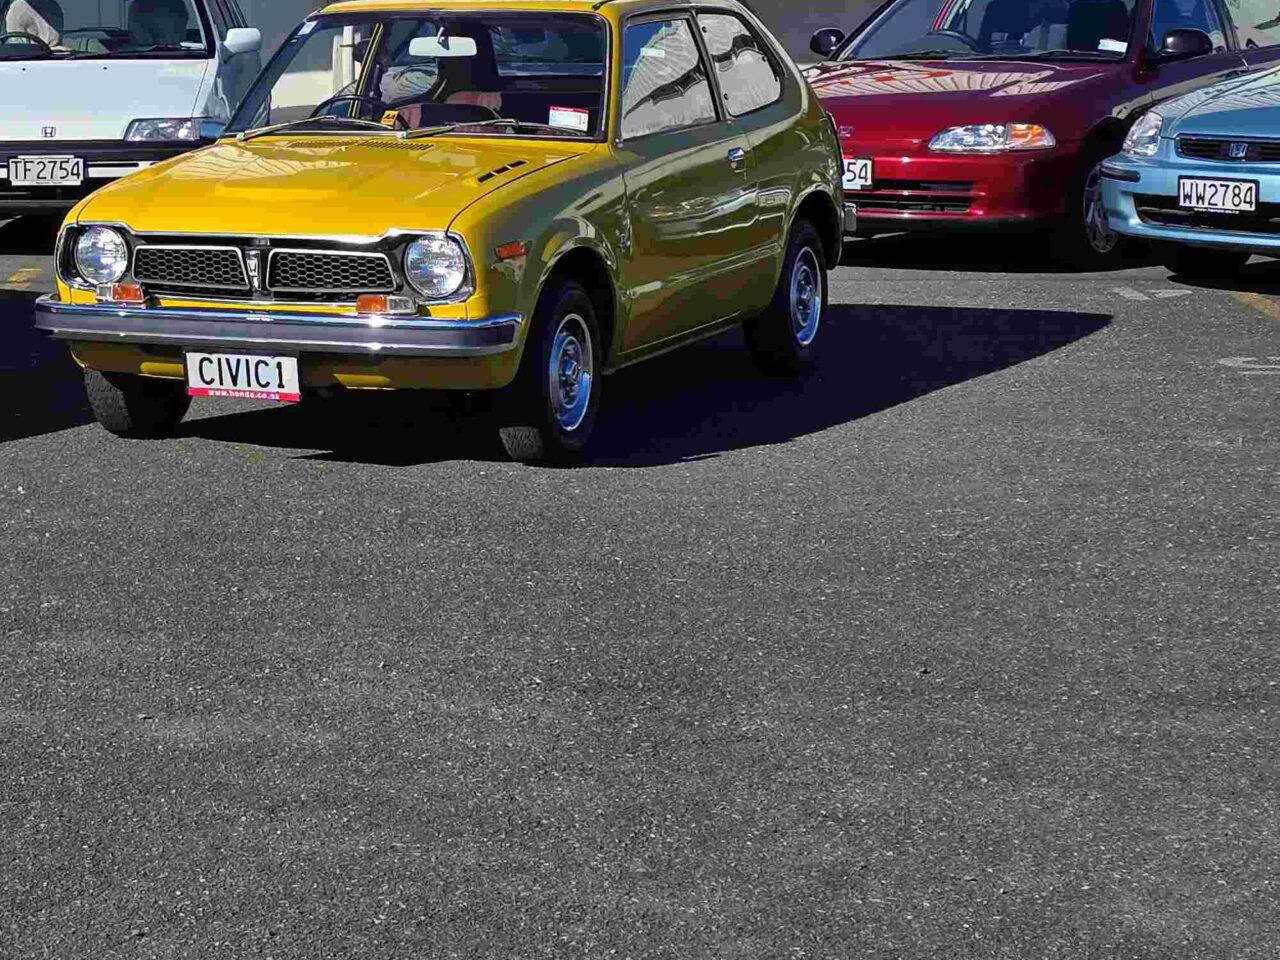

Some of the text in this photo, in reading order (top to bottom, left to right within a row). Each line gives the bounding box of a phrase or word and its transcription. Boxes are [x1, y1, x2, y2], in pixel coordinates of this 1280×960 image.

[11, 160, 81, 180] TF2754
[1181, 181, 1254, 209] WW2784
[198, 356, 286, 389] CIVIC1
